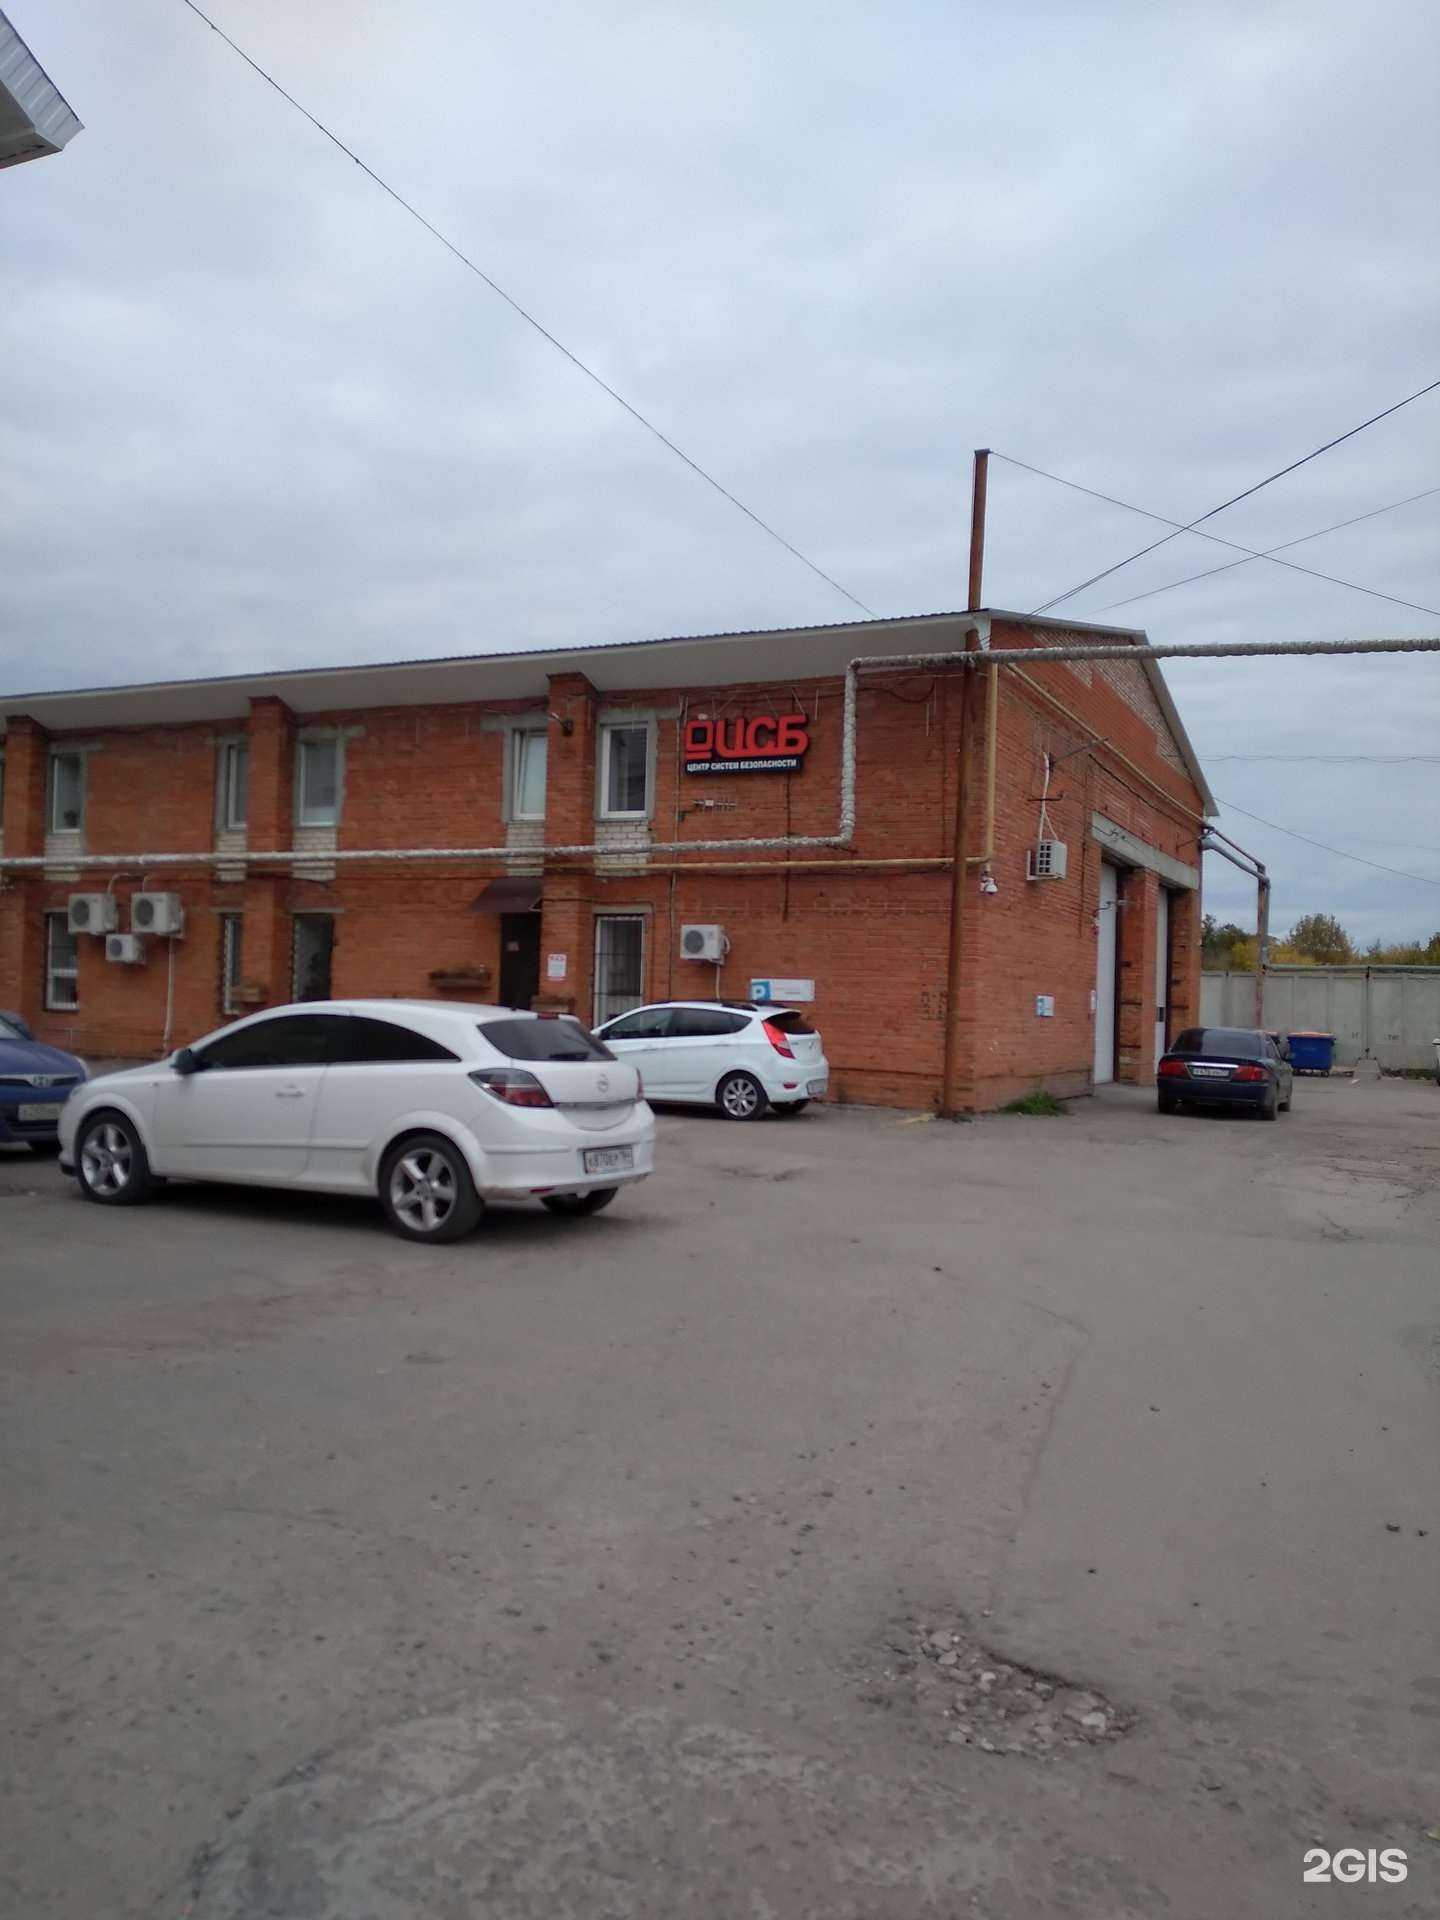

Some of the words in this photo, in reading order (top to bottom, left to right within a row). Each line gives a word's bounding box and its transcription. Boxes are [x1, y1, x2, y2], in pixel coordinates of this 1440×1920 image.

[687, 763, 710, 772] ЦЕНТР
[711, 762, 739, 770] СИСТЕМ
[740, 759, 797, 769] БЕЗОПАСНОСТИ
